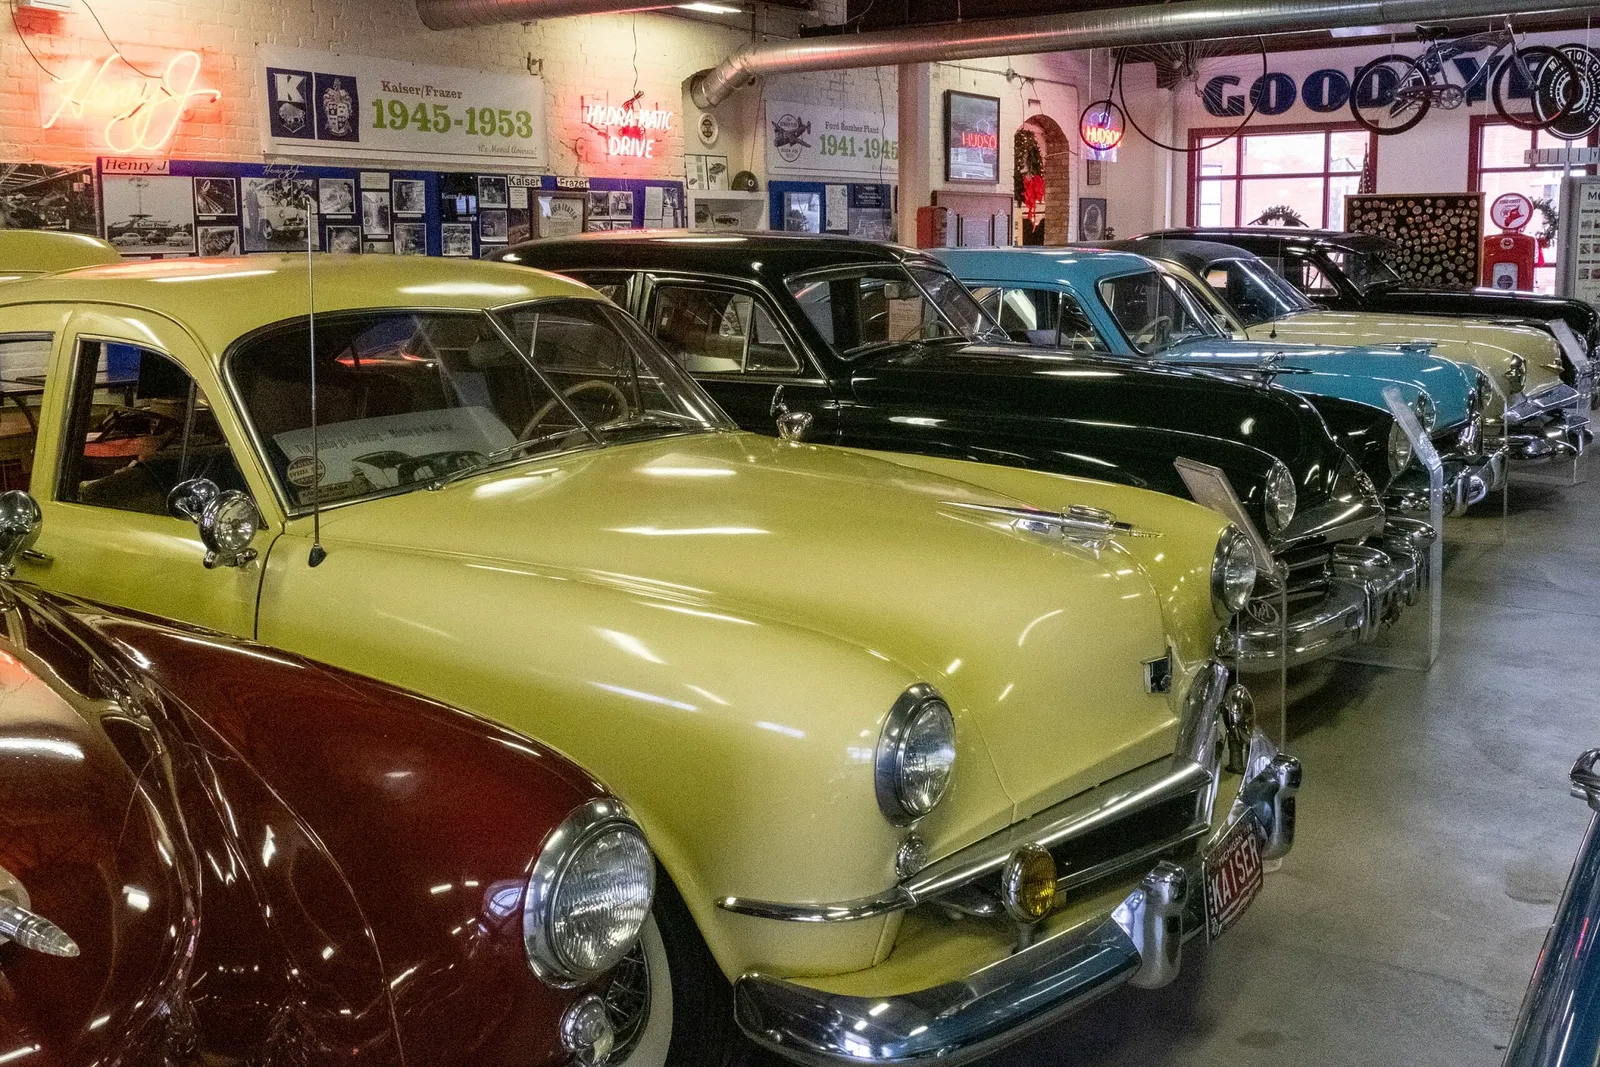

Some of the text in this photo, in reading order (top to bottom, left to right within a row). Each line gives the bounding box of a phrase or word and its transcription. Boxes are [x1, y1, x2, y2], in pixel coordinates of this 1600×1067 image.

[381, 80, 463, 99] Kaiser/Frazer
[371, 98, 533, 139] 1945-1953
[586, 104, 674, 129] HYDRA-MATIC
[608, 136, 655, 158] DRIVE
[820, 134, 898, 160] 1941-1945
[1086, 126, 1121, 147] HUDSON
[105, 159, 167, 173] Henry J
[508, 175, 540, 187] Kaiser
[1587, 191, 1600, 200] M
[1211, 832, 1261, 915] KAISER
